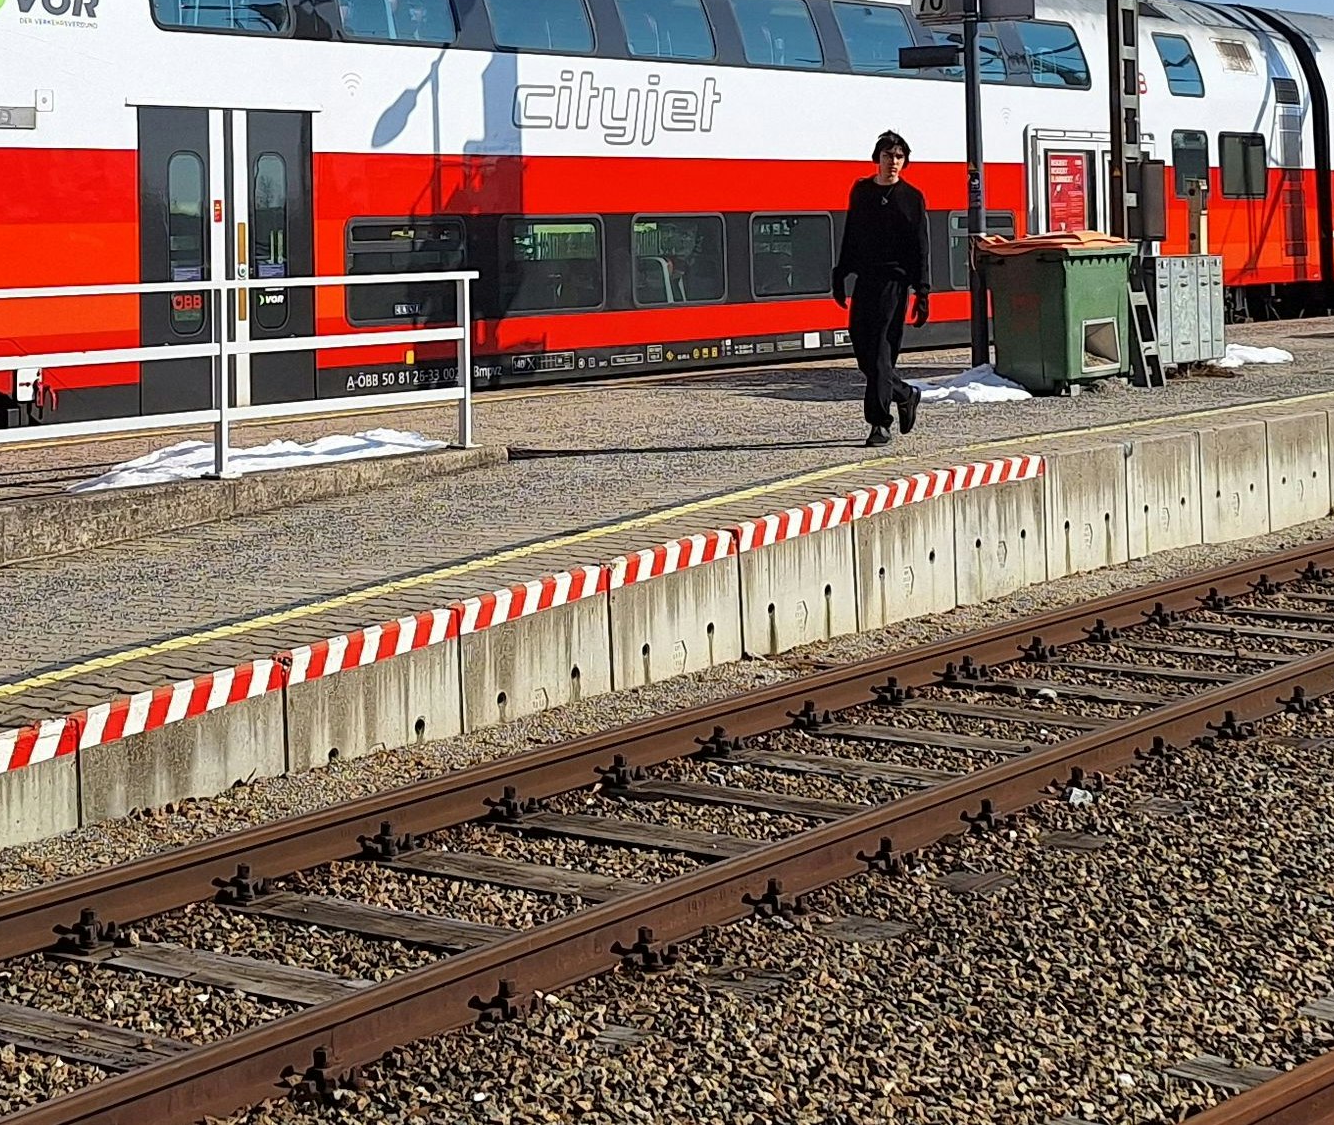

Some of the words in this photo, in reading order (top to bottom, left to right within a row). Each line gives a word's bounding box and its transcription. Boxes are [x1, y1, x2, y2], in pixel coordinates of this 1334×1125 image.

[512, 70, 721, 146] cityjet
[382, 373, 395, 386] 50
[398, 371, 410, 384] 81
